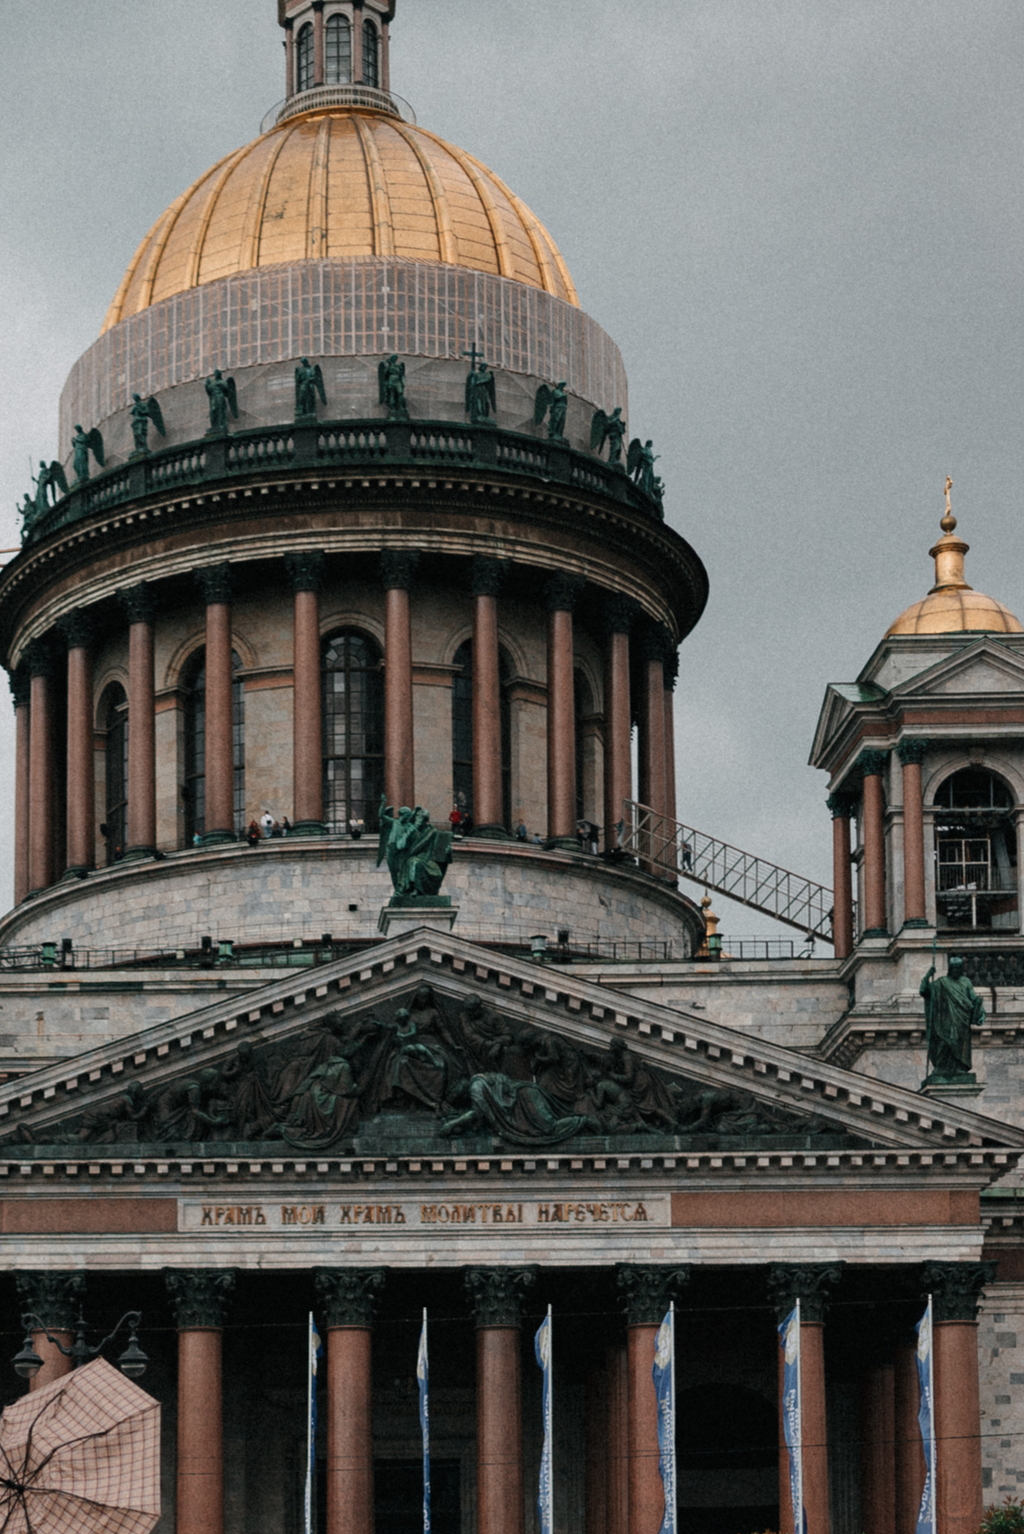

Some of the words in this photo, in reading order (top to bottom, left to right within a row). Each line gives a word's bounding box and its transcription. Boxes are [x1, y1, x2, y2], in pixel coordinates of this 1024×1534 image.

[200, 1205, 267, 1226] ХРАМЪ
[339, 1204, 406, 1225] ХРАМЪ
[420, 1203, 524, 1224] МОЛИТВЫ
